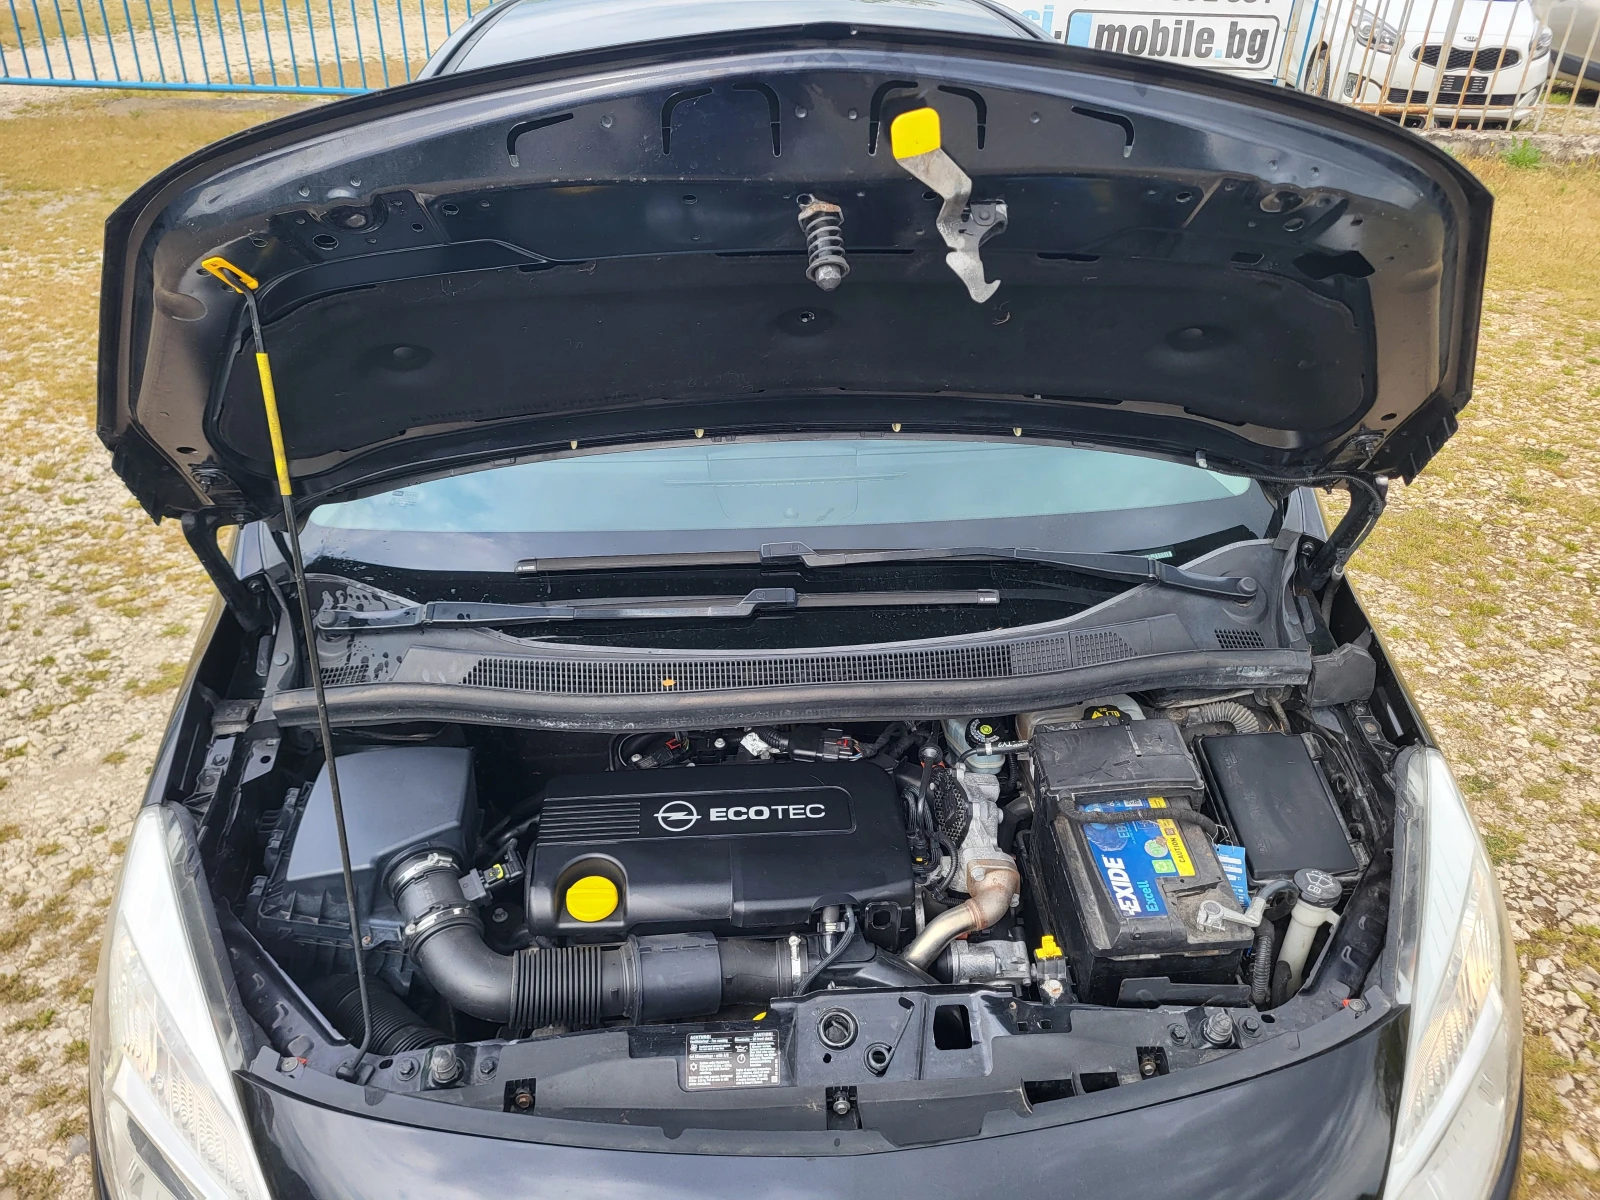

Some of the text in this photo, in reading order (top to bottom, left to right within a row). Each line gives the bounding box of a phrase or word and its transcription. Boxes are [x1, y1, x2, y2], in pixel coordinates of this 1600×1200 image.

[1094, 18, 1270, 64] mobile.bg
[709, 803, 826, 822] ECOTEC
[1169, 837, 1186, 863] CAUTION
[1102, 857, 1142, 916] EXIDE
[1136, 880, 1160, 912] Excell
